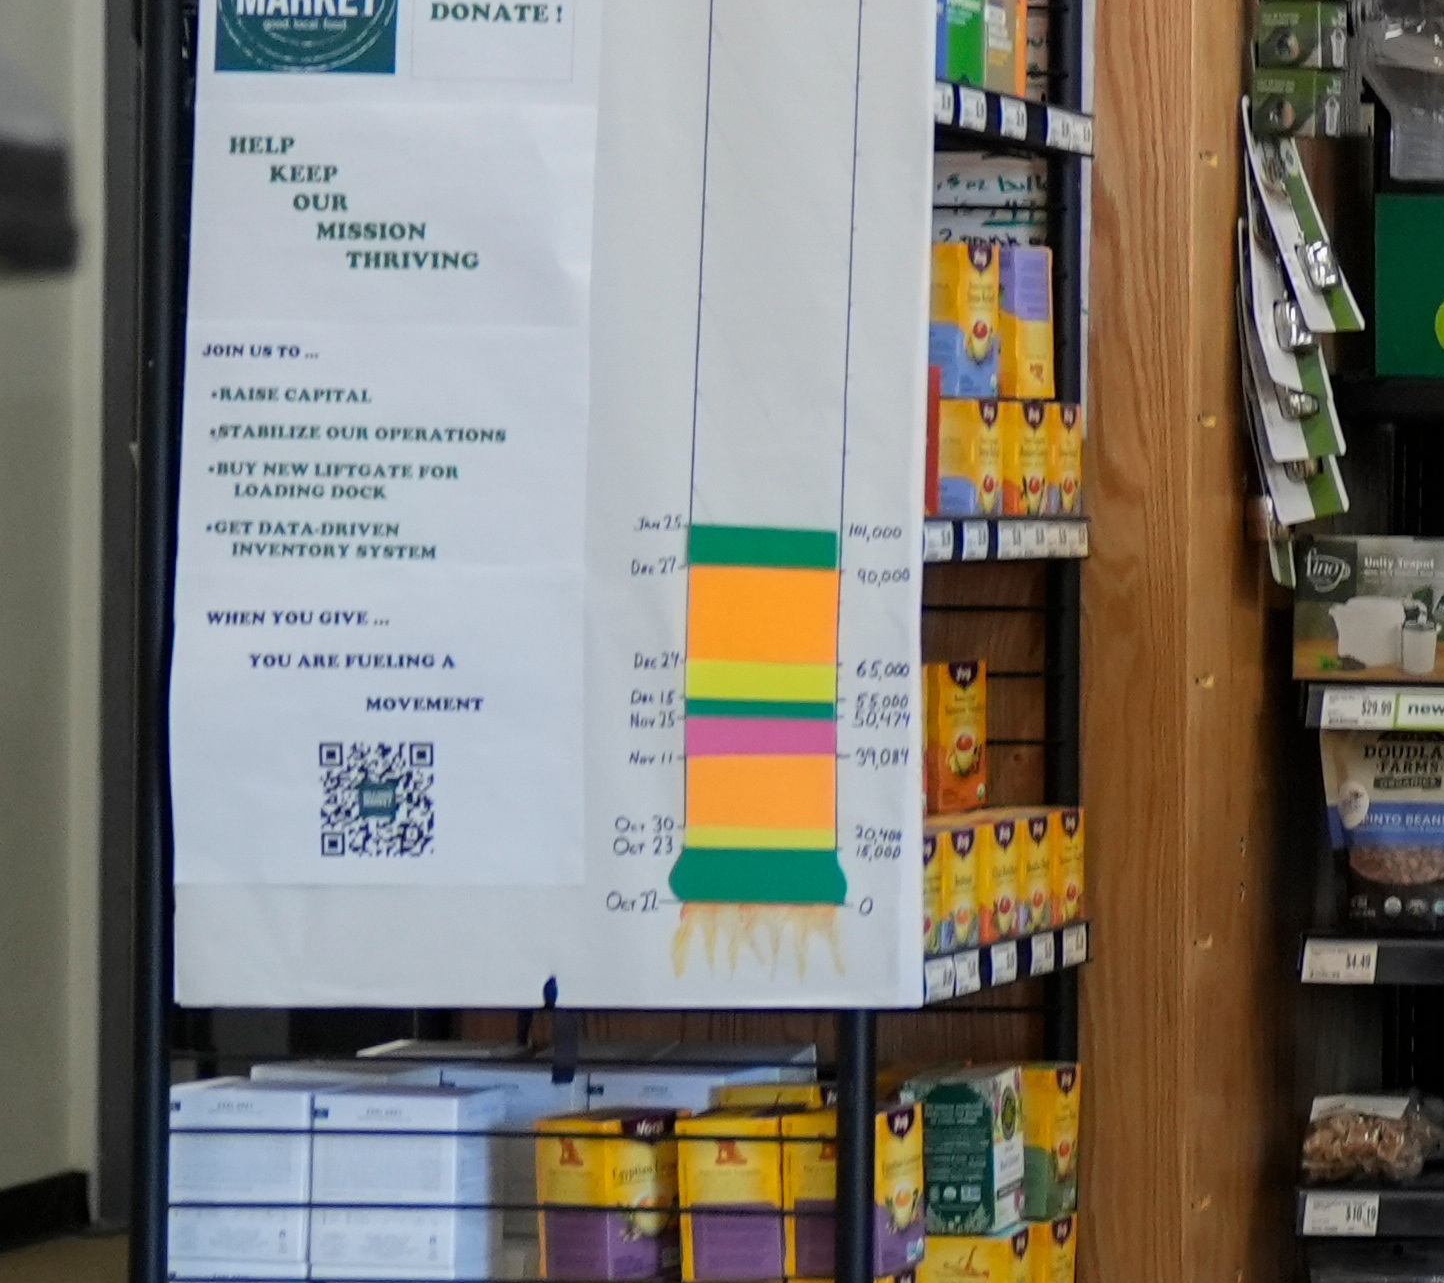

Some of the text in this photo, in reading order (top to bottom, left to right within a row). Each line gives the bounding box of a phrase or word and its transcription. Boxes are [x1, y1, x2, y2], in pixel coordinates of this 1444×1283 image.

[431, 3, 548, 22] DONATE
[230, 137, 294, 154] HELP
[270, 165, 338, 183] KEEP
[293, 194, 348, 211] OUR
[317, 223, 426, 240] MISSION
[347, 252, 479, 269] THRIVING
[203, 345, 300, 357] JOIN US TO
[220, 388, 371, 403] RAISE CAPITAL
[218, 425, 507, 442] STABILIZE OUR OPERATIONS
[217, 462, 459, 479] BUY NEW LIFTGATE FOR
[235, 484, 386, 500] LOADING DOCK
[214, 522, 399, 536] GET DATA-DRIVEN
[634, 515, 682, 530] Jan 25
[850, 524, 901, 541] 101,000
[232, 544, 436, 559] INVENTORY SYSTEM
[631, 558, 676, 574] Dec 27
[858, 569, 910, 586] 90,000
[207, 611, 368, 625] WHEN YOU GIVE
[250, 654, 455, 668] YOU ARE FUELING A
[634, 652, 680, 668] Dec 24
[856, 661, 909, 678] 65,000
[366, 697, 483, 711] MOVEMENT
[631, 691, 653, 704] Dec
[857, 693, 908, 710] 55,000
[1361, 700, 1392, 716] $29.99
[630, 716, 655, 728] Nov
[629, 753, 673, 764] Nov 11
[615, 816, 674, 831] Oct 30
[613, 837, 673, 855] Oct 23
[606, 892, 635, 911] Oct
[860, 898, 873, 915] 0
